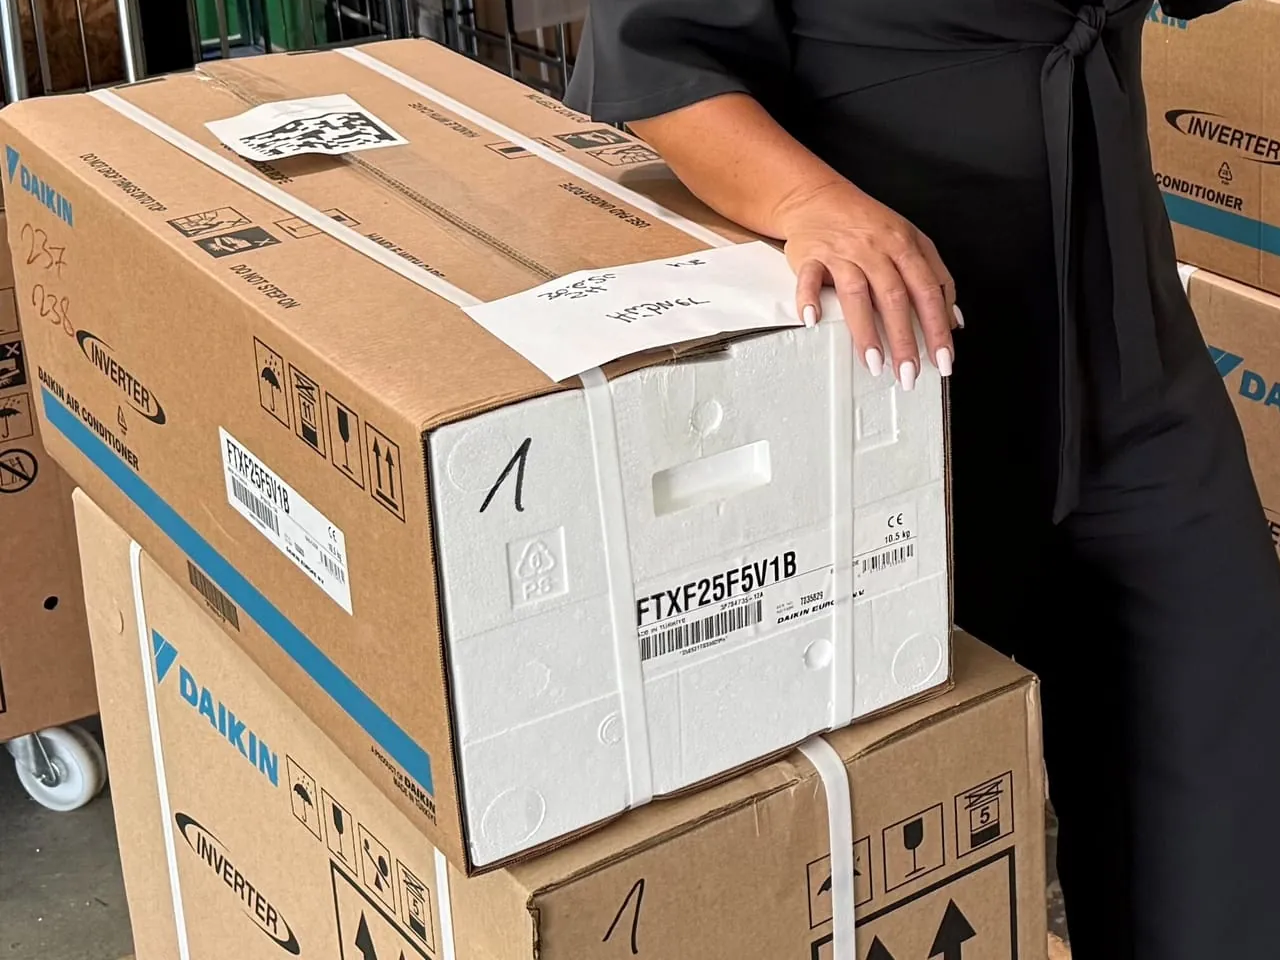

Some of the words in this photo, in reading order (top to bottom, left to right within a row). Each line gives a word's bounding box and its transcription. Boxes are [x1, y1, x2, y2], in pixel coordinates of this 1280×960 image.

[20, 163, 74, 228] DAIKIN
[1155, 172, 1244, 212] CONDITIONER
[21, 223, 67, 280] 237
[32, 283, 76, 338] 238
[91, 341, 151, 413] INVERTER
[38, 365, 65, 401] DAIKIN
[66, 393, 81, 417] AIR
[81, 407, 140, 471] CONDITIONER
[226, 438, 290, 515] FTXF25F5V1B
[885, 532, 900, 544] 10.5
[636, 550, 797, 627] FTXF25F5V1B
[777, 607, 810, 625] DAIKIN
[179, 664, 279, 788] DAIKIN
[404, 775, 436, 814] DAIKIN
[196, 831, 278, 936] INVERTER
